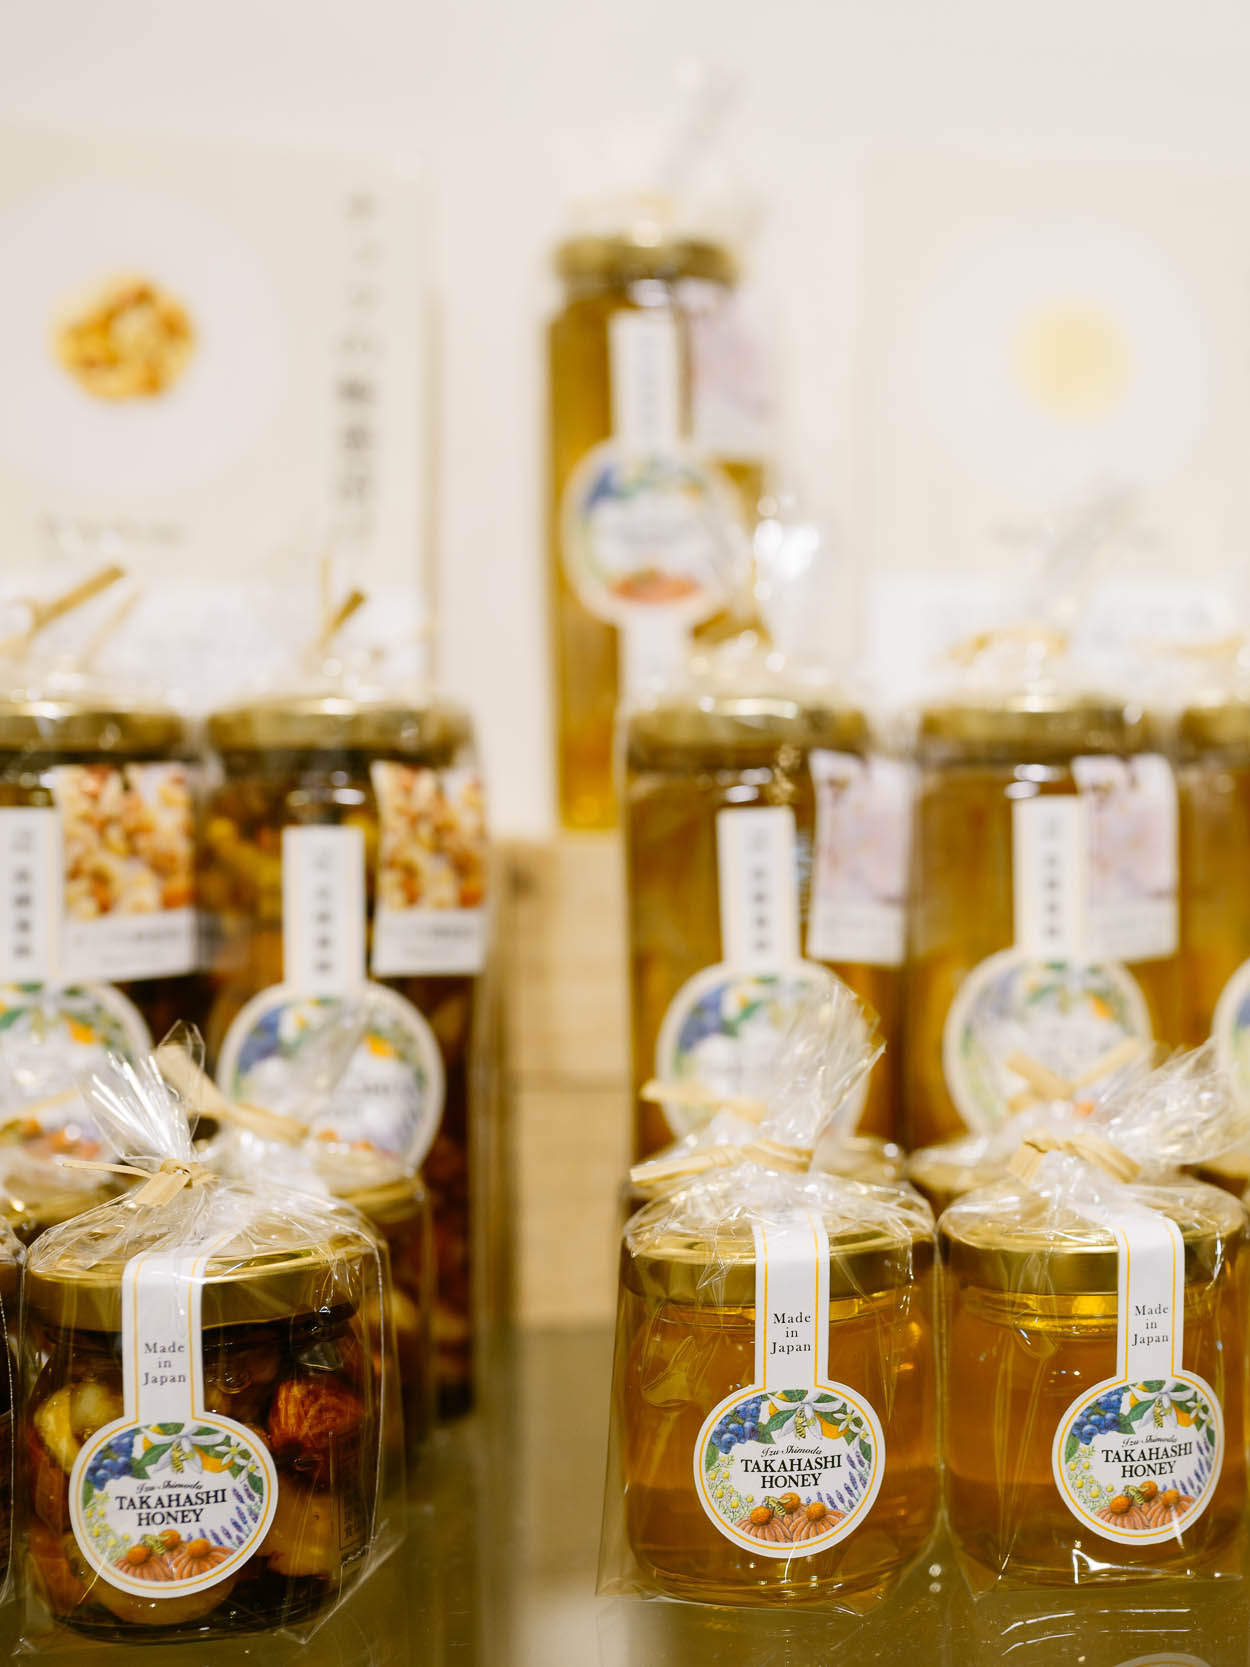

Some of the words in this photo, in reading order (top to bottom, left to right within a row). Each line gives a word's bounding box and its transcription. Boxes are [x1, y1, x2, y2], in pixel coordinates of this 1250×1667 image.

[1134, 1303, 1169, 1316] Made
[773, 1311, 812, 1324] Made
[1145, 1318, 1157, 1330] in
[785, 1326, 799, 1338] in
[1131, 1333, 1169, 1347] Japan
[144, 1341, 186, 1354] Made
[769, 1341, 812, 1355] Japan
[158, 1356, 172, 1369] in
[142, 1372, 187, 1386] Japan
[760, 1446, 780, 1458] Izu
[781, 1444, 823, 1456] Shimoda
[1101, 1441, 1193, 1463] TAKAHASHI
[740, 1454, 843, 1473] TAKAHASHI
[1121, 1460, 1177, 1479] HONEY
[760, 1472, 823, 1489] HONEY
[115, 1488, 228, 1511] TAKAHASHI
[136, 1508, 204, 1527] HONEY
